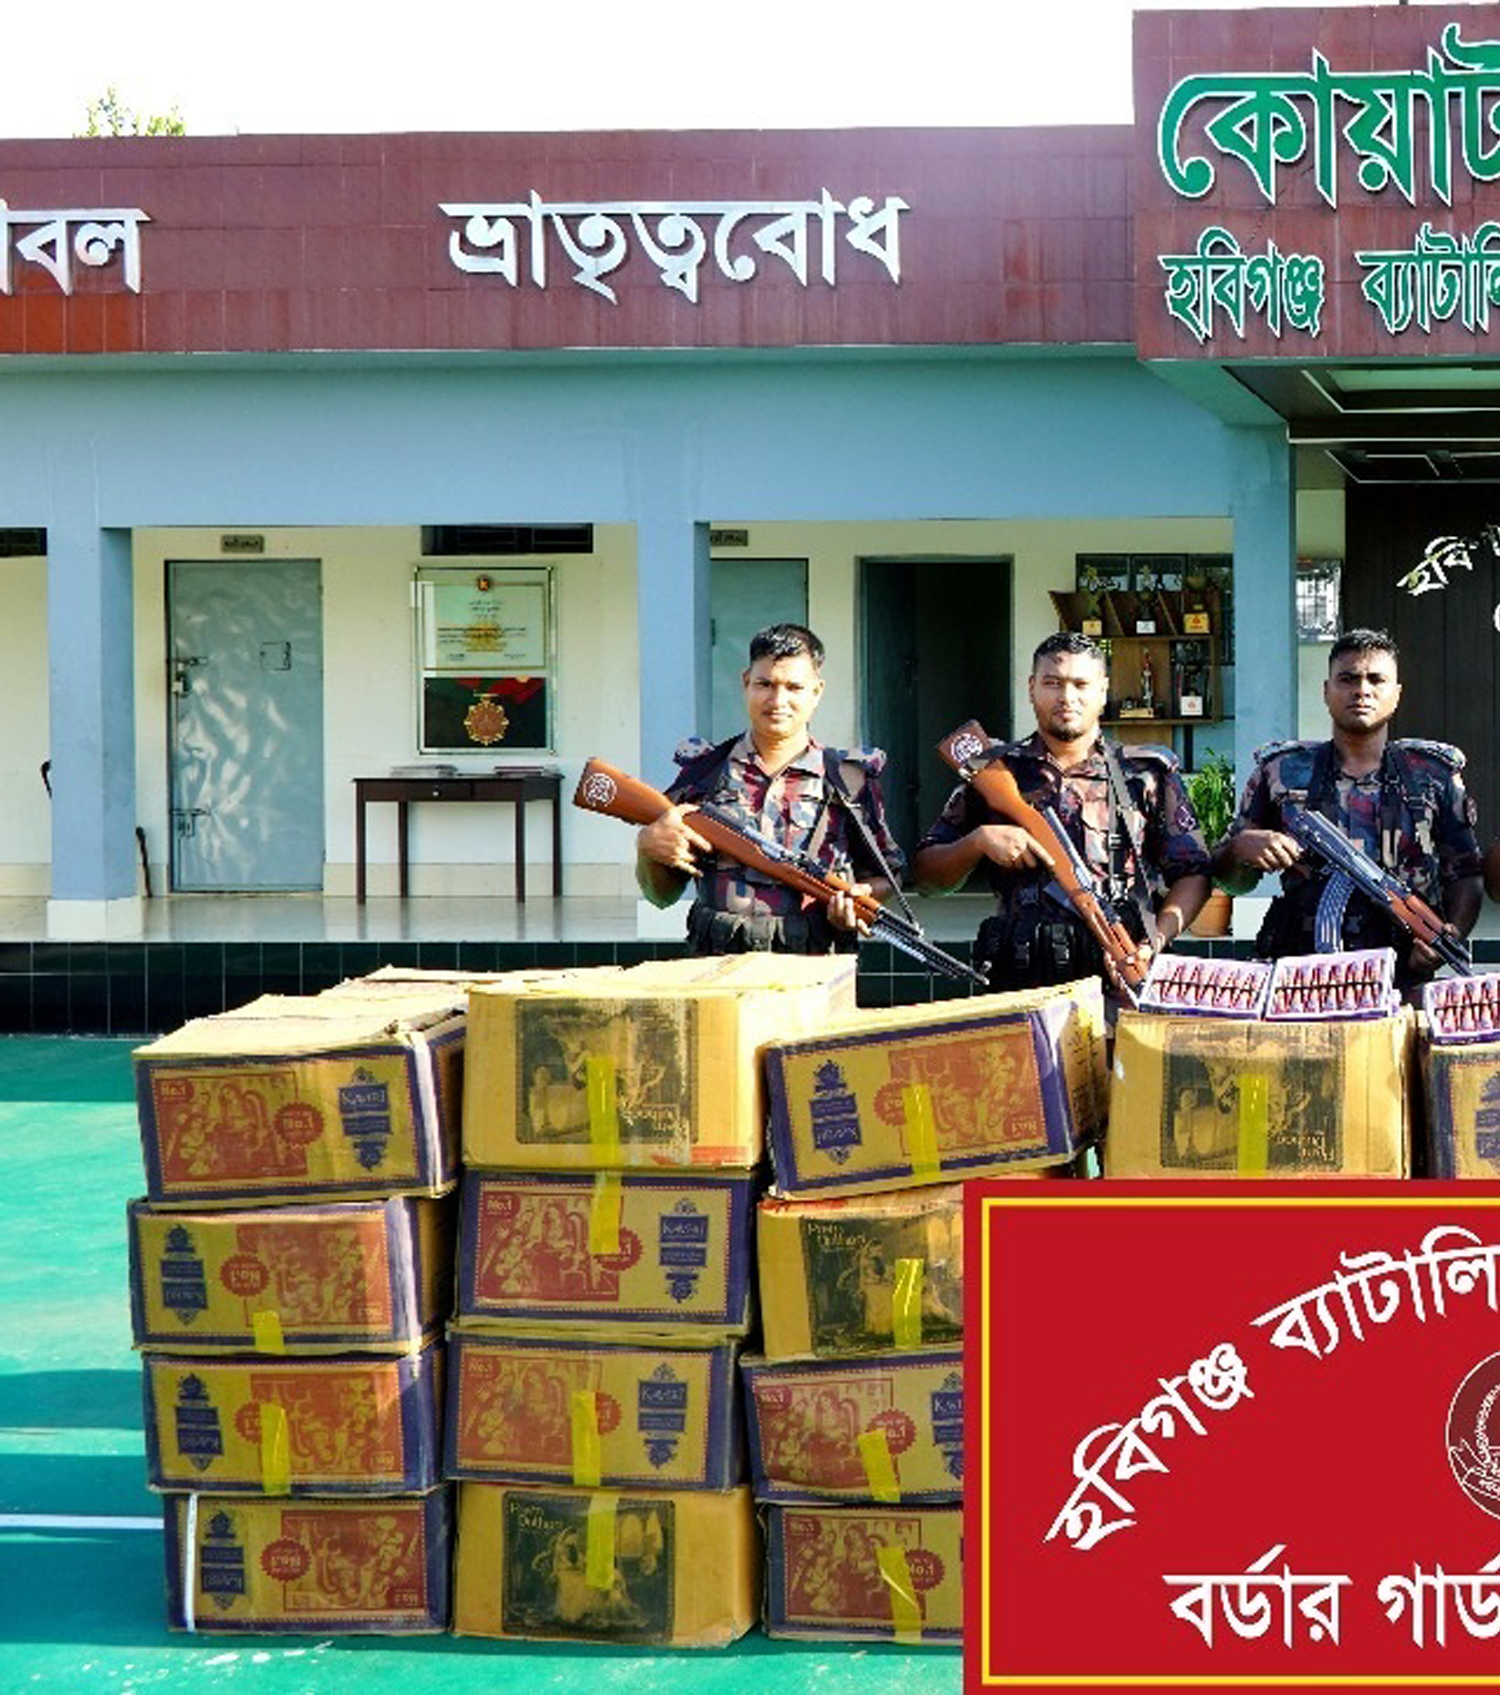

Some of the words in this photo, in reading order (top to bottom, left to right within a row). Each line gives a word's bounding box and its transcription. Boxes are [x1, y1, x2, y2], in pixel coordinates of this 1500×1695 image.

[440, 188, 911, 304] ভ্রাতৃত্ববোধ
[1158, 227, 1324, 343] হবিগঞ্জ
[283, 1118, 313, 1129] No.1
[487, 1199, 512, 1210] No.1
[272, 1555, 301, 1567] No.1
